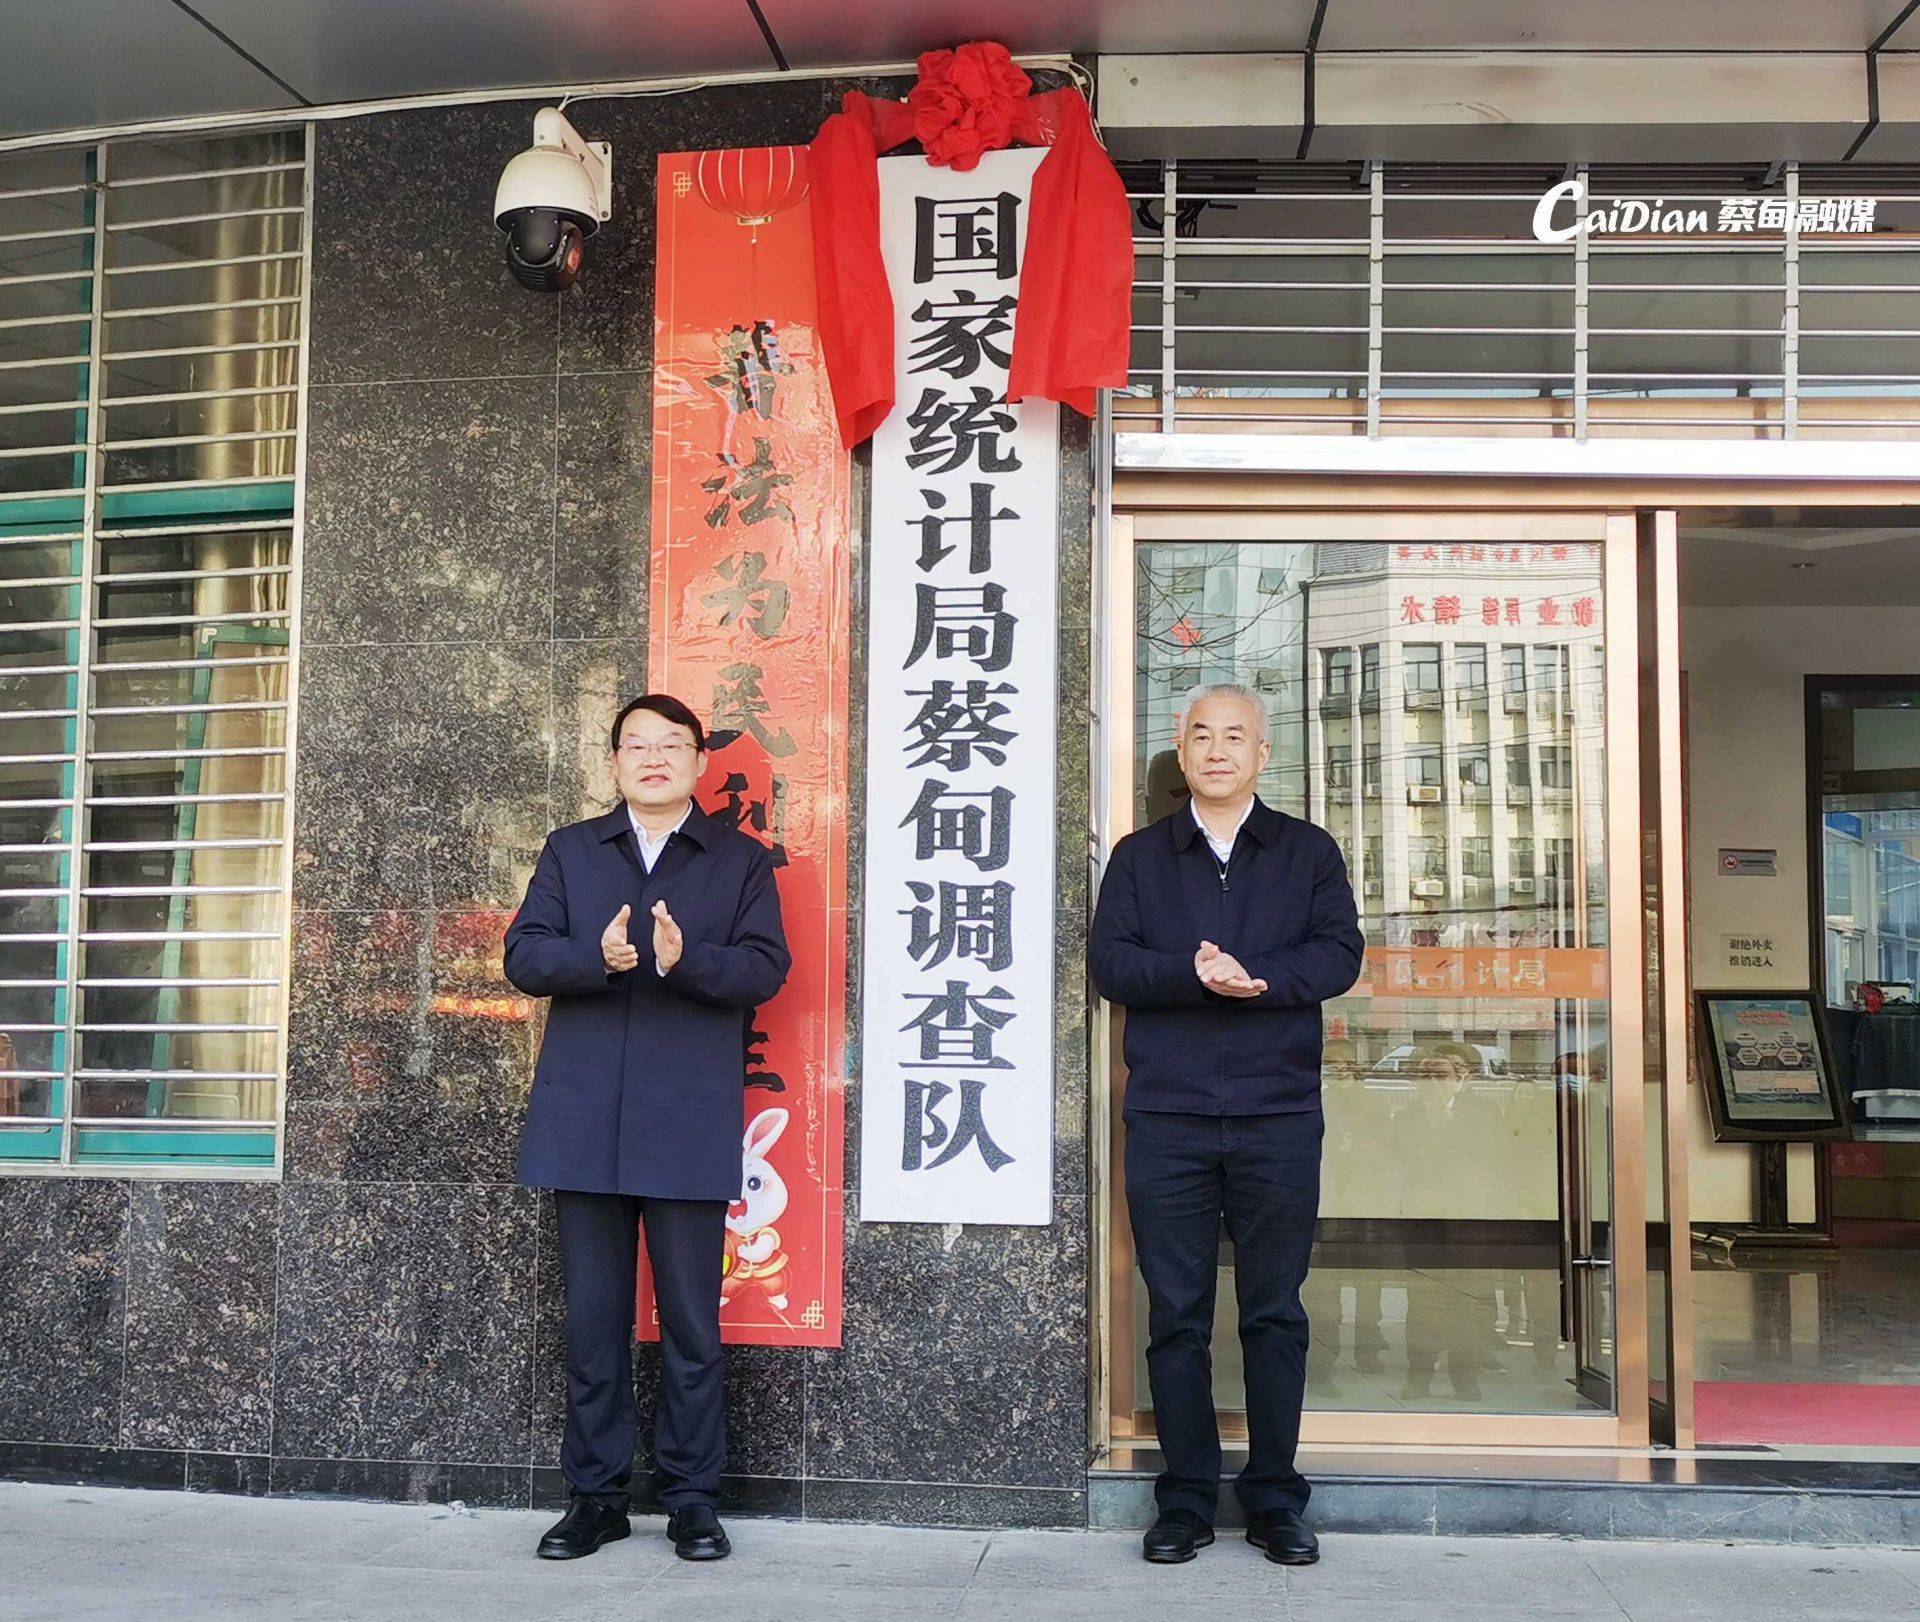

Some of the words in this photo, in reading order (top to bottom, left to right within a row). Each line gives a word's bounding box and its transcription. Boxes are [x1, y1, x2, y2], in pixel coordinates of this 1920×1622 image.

[897, 191, 1023, 1174] 国家统计局蔡甸调查队
